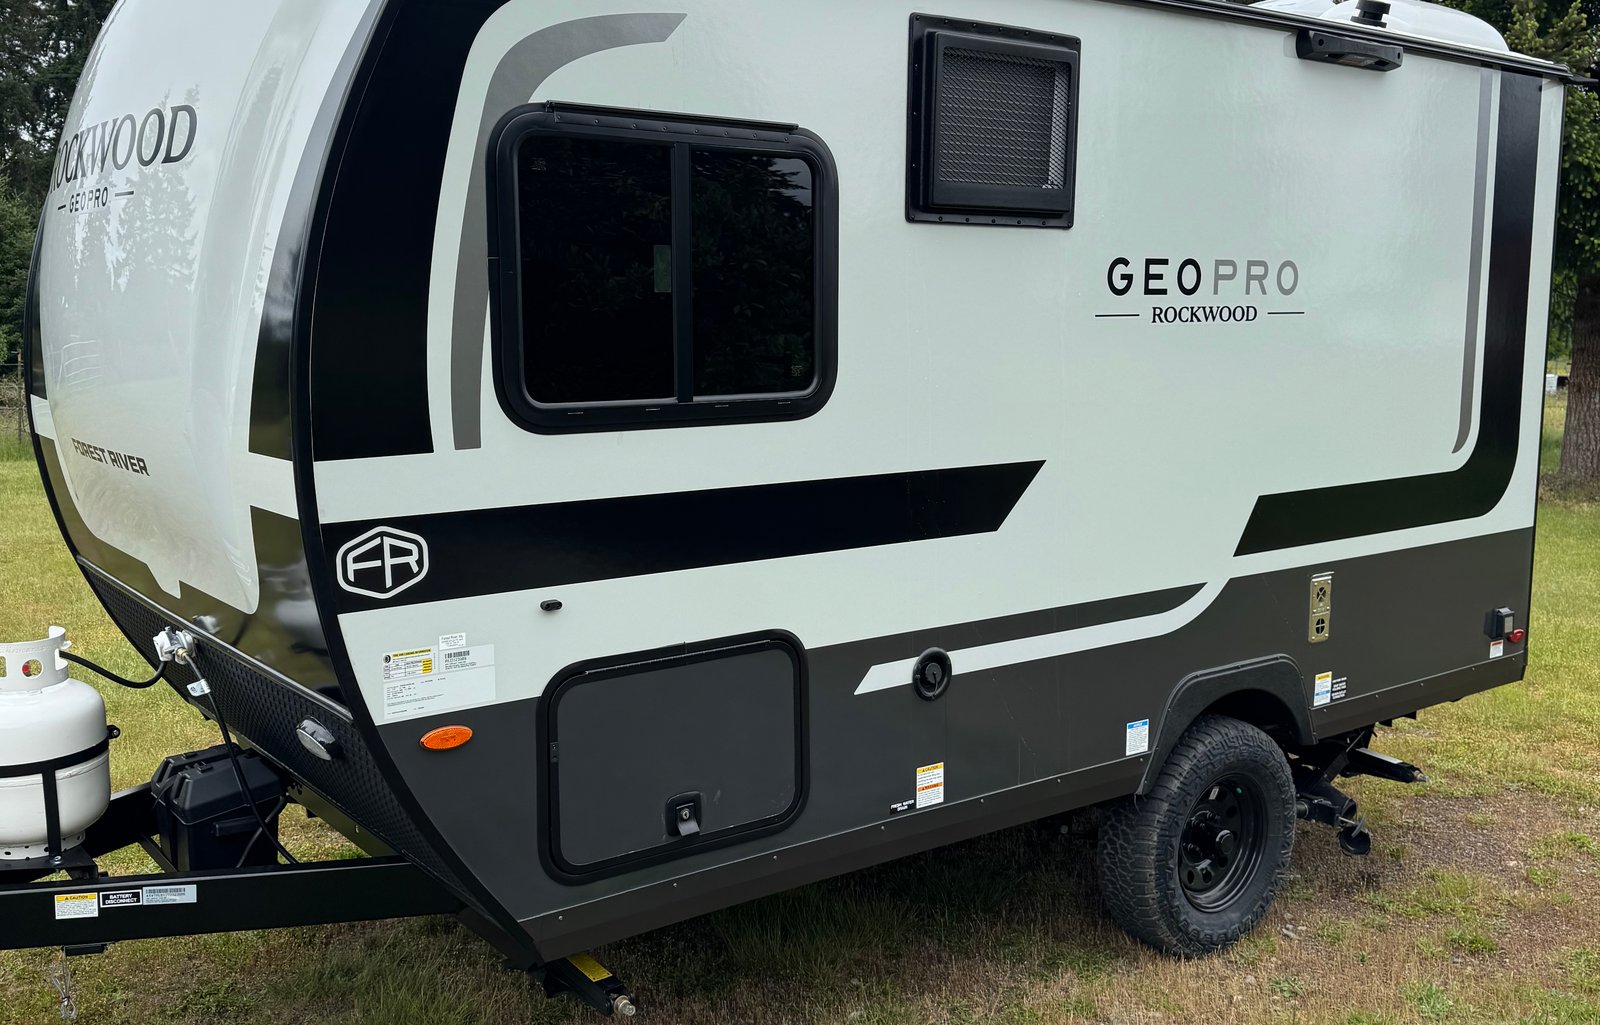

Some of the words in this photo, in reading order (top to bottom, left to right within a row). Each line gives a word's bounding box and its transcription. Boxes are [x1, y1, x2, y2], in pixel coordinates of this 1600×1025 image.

[69, 186, 109, 214] GEOPRO
[1151, 305, 1258, 324] ROCKWOOD
[71, 437, 108, 465] FOREST
[106, 449, 151, 477] RIVER
[105, 897, 138, 905] DISCONNECT
